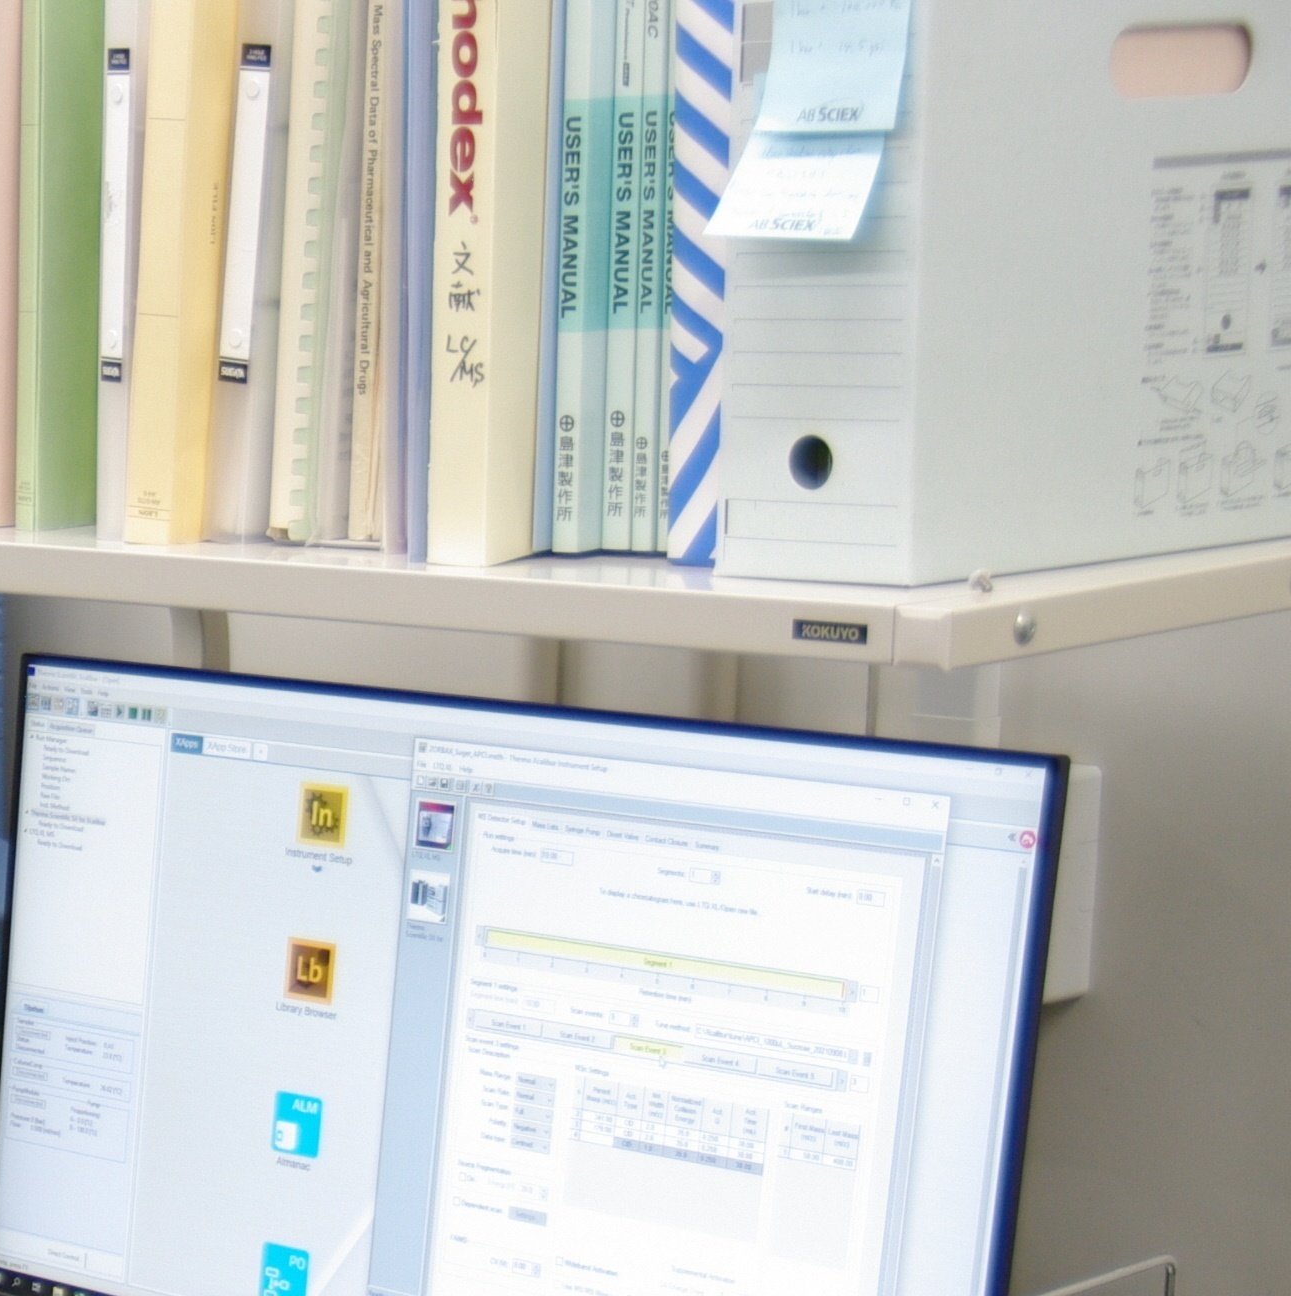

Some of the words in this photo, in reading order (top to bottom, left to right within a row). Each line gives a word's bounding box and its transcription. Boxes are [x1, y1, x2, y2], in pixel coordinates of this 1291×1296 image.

[372, 4, 383, 35] Mass
[370, 39, 382, 92] Spectral
[368, 96, 380, 131] Data
[797, 107, 815, 122] AB
[818, 104, 863, 122] SCIEX
[368, 132, 378, 145] of
[564, 116, 582, 206] USER'S
[616, 111, 634, 202] USER'S
[642, 110, 657, 200] USER'S
[363, 149, 379, 247] Pharmaceutical
[769, 216, 820, 231] SCIEX
[363, 250, 374, 274] and
[561, 214, 579, 318] MANUAL
[612, 209, 631, 314] MANUAL
[639, 209, 655, 314] MANUAL
[359, 279, 374, 355] Agricultural
[356, 359, 370, 396] Drugs
[801, 623, 860, 641] KOKUYO
[175, 736, 198, 749] XApps
[311, 800, 335, 828] In
[285, 847, 327, 862] Instrument
[329, 851, 353, 867] Setup
[295, 955, 323, 983] Lb
[275, 1001, 303, 1017] Library
[305, 1006, 337, 1021] Browser
[292, 1099, 319, 1116] ALM
[276, 1155, 311, 1172] Almanac
[288, 1254, 307, 1271] PO
